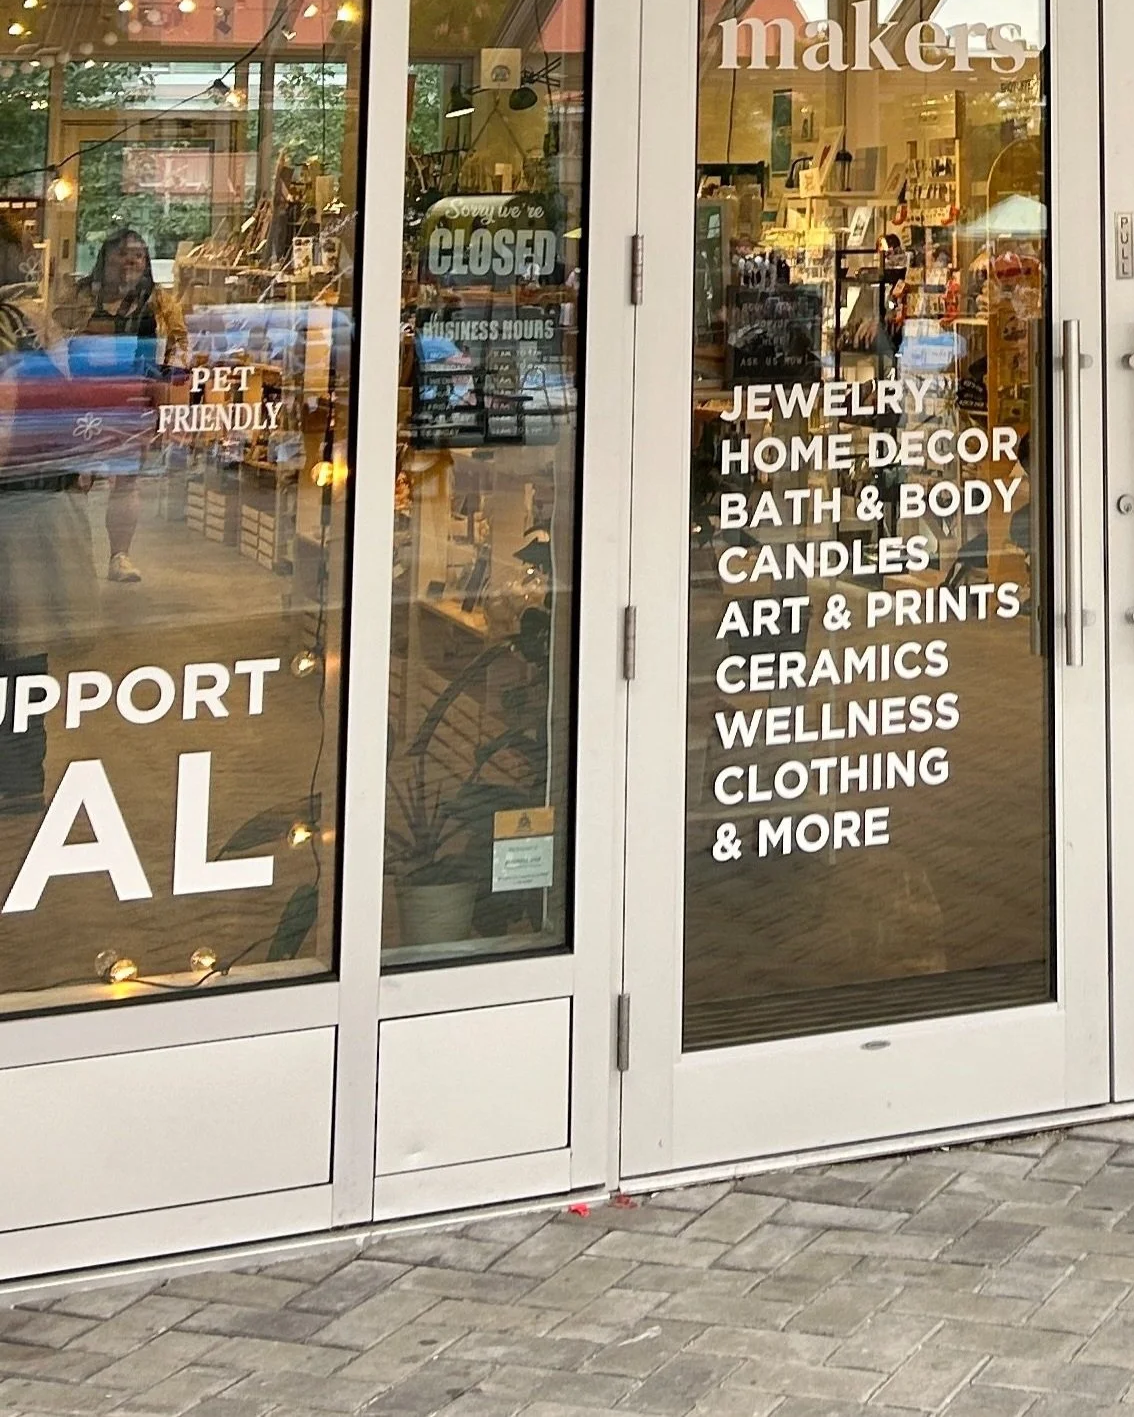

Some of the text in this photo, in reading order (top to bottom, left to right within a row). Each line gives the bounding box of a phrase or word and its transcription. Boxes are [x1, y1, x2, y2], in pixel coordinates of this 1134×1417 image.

[717, 0, 1026, 74] makers
[445, 198, 496, 225] Sorry
[428, 227, 556, 276] CLOSED
[1119, 216, 1130, 276] PULL
[502, 319, 554, 340] HOURS
[190, 366, 256, 394] PET
[720, 381, 931, 421] JEWELRY
[157, 401, 284, 434] FRIENDLY
[722, 427, 1018, 475] HOME DECOR
[721, 478, 1022, 530] BATH & BODY
[719, 536, 930, 584] CANDLES
[716, 583, 1021, 639] ART & PRINTS
[715, 639, 949, 694] CERAMICS
[0, 658, 280, 732] PPORT
[715, 692, 960, 750] WELLNESS
[714, 748, 950, 805] CLOTHING
[712, 807, 891, 862] & MORE
